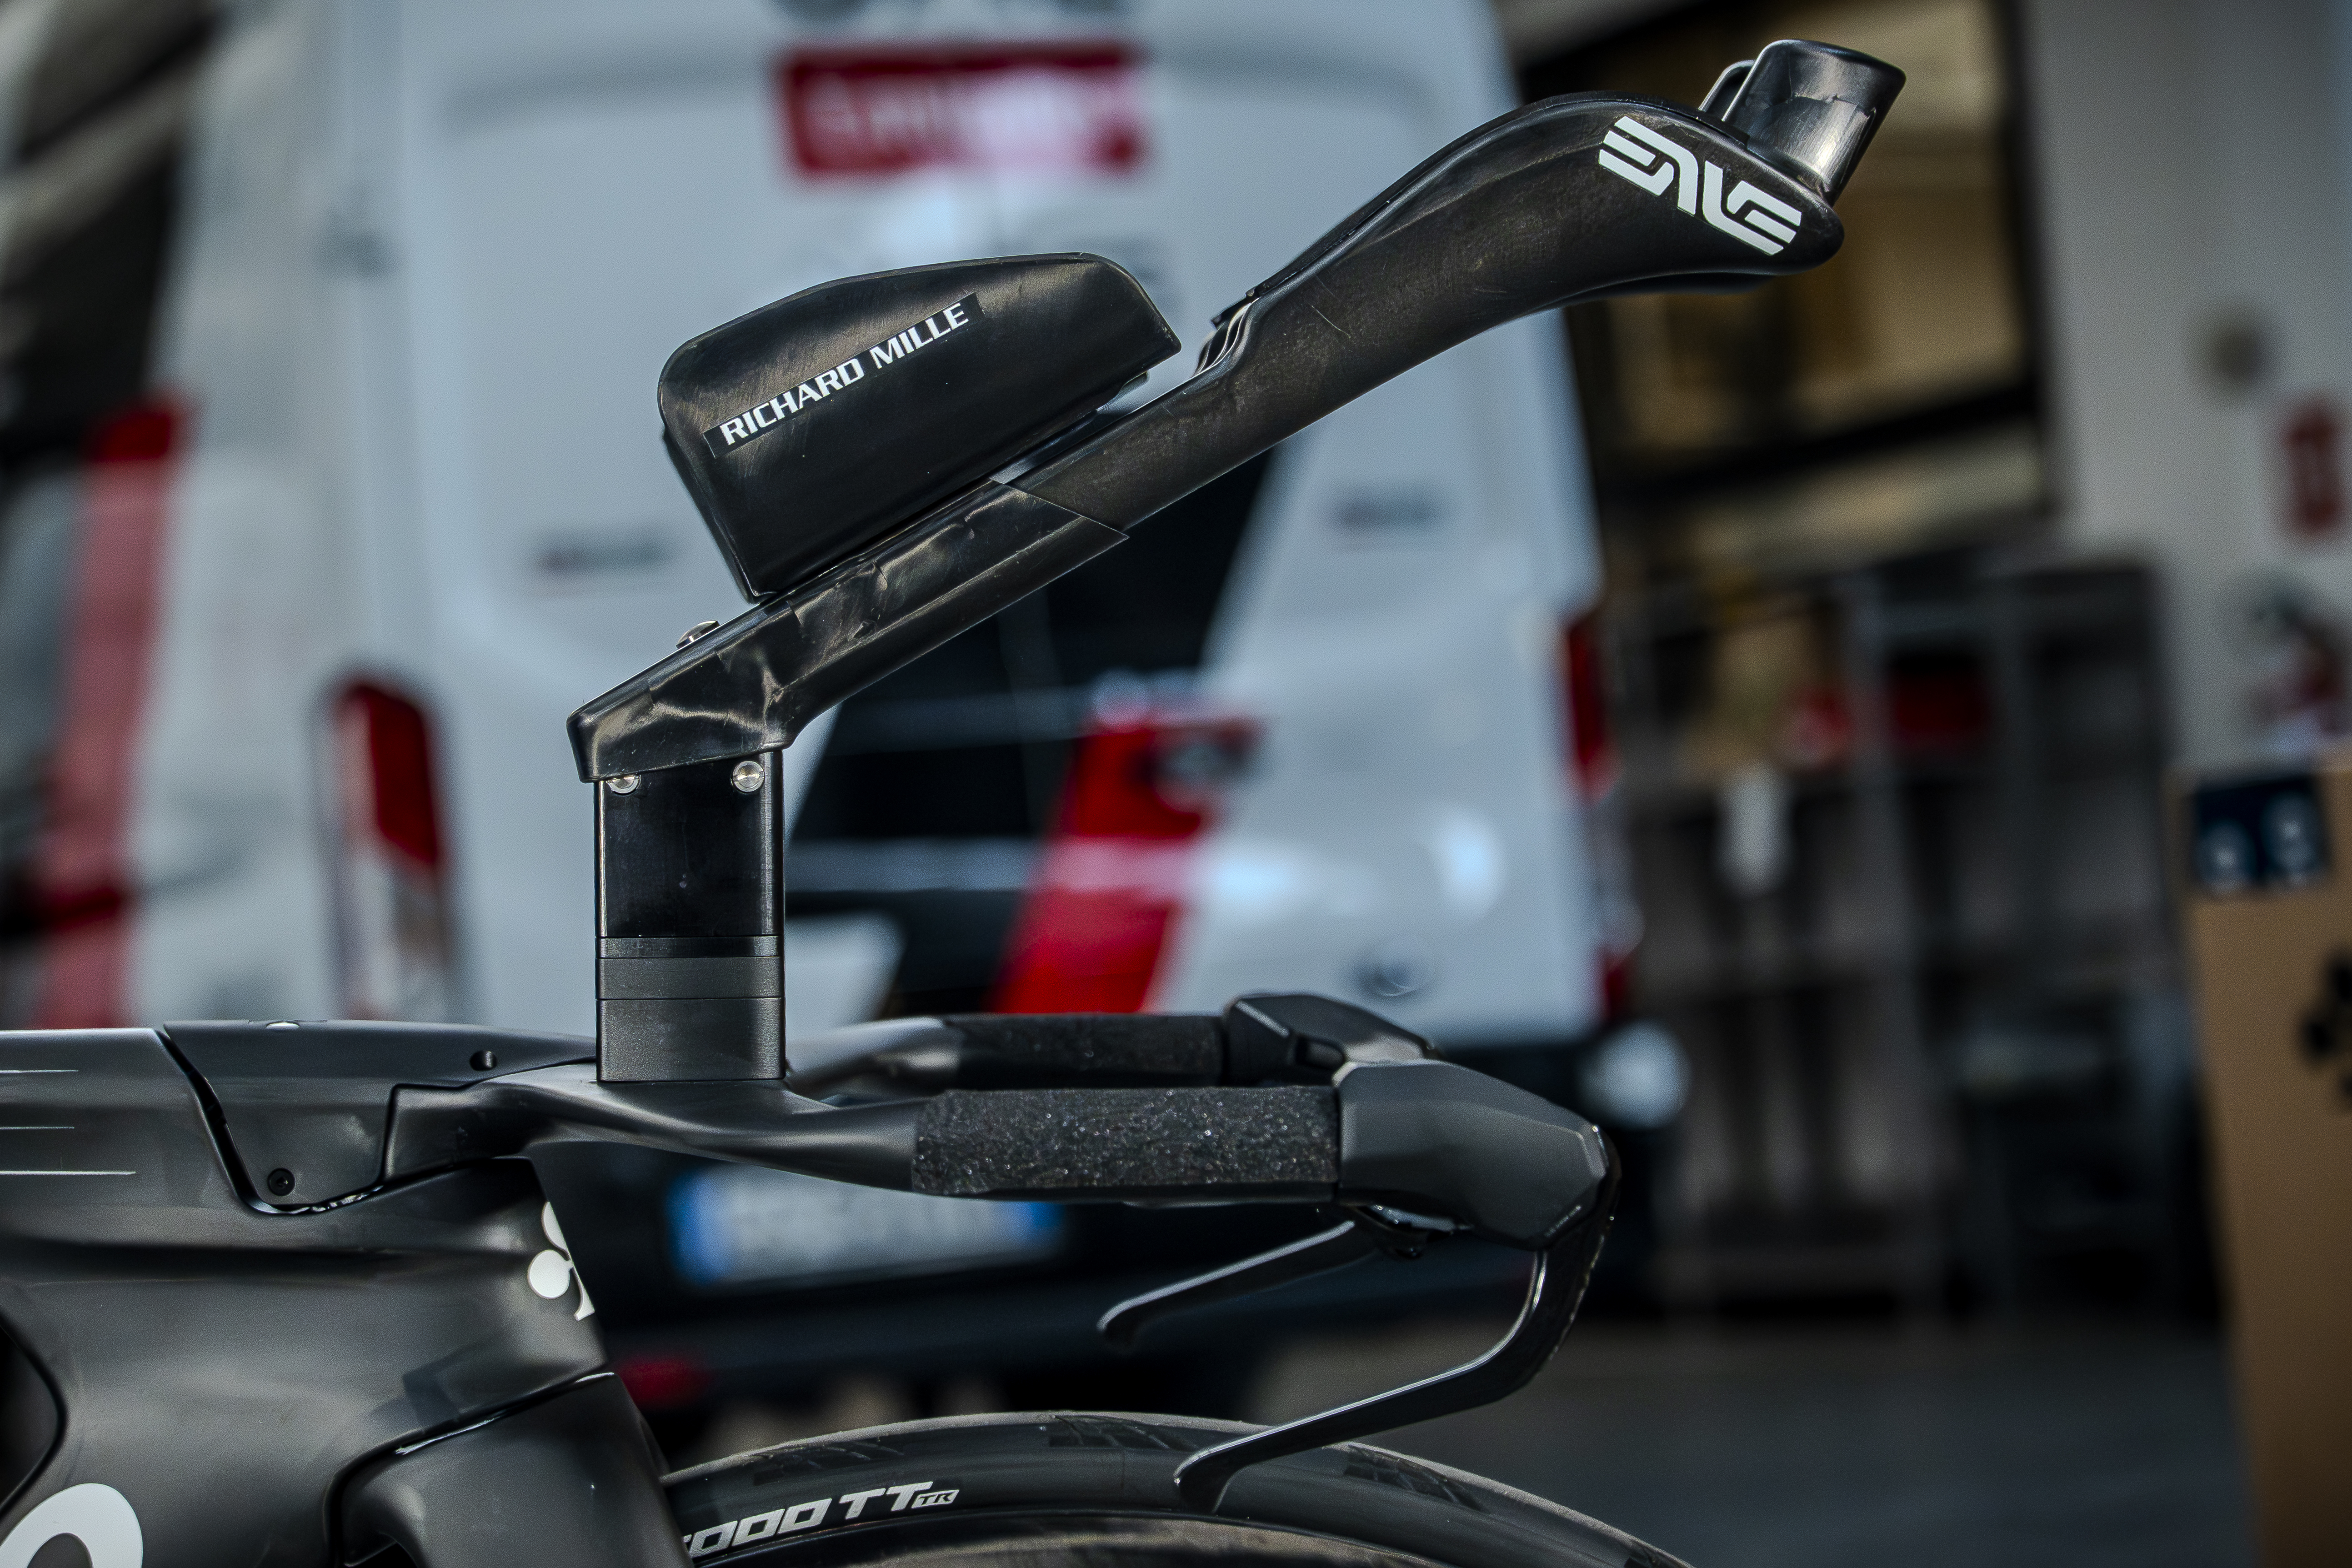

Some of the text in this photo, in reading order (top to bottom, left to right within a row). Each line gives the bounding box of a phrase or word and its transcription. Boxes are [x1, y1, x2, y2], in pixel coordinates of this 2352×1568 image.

[720, 303, 969, 445] RICHARD MILLE
[683, 1498, 832, 1558] 000
[840, 1481, 933, 1519] TT
